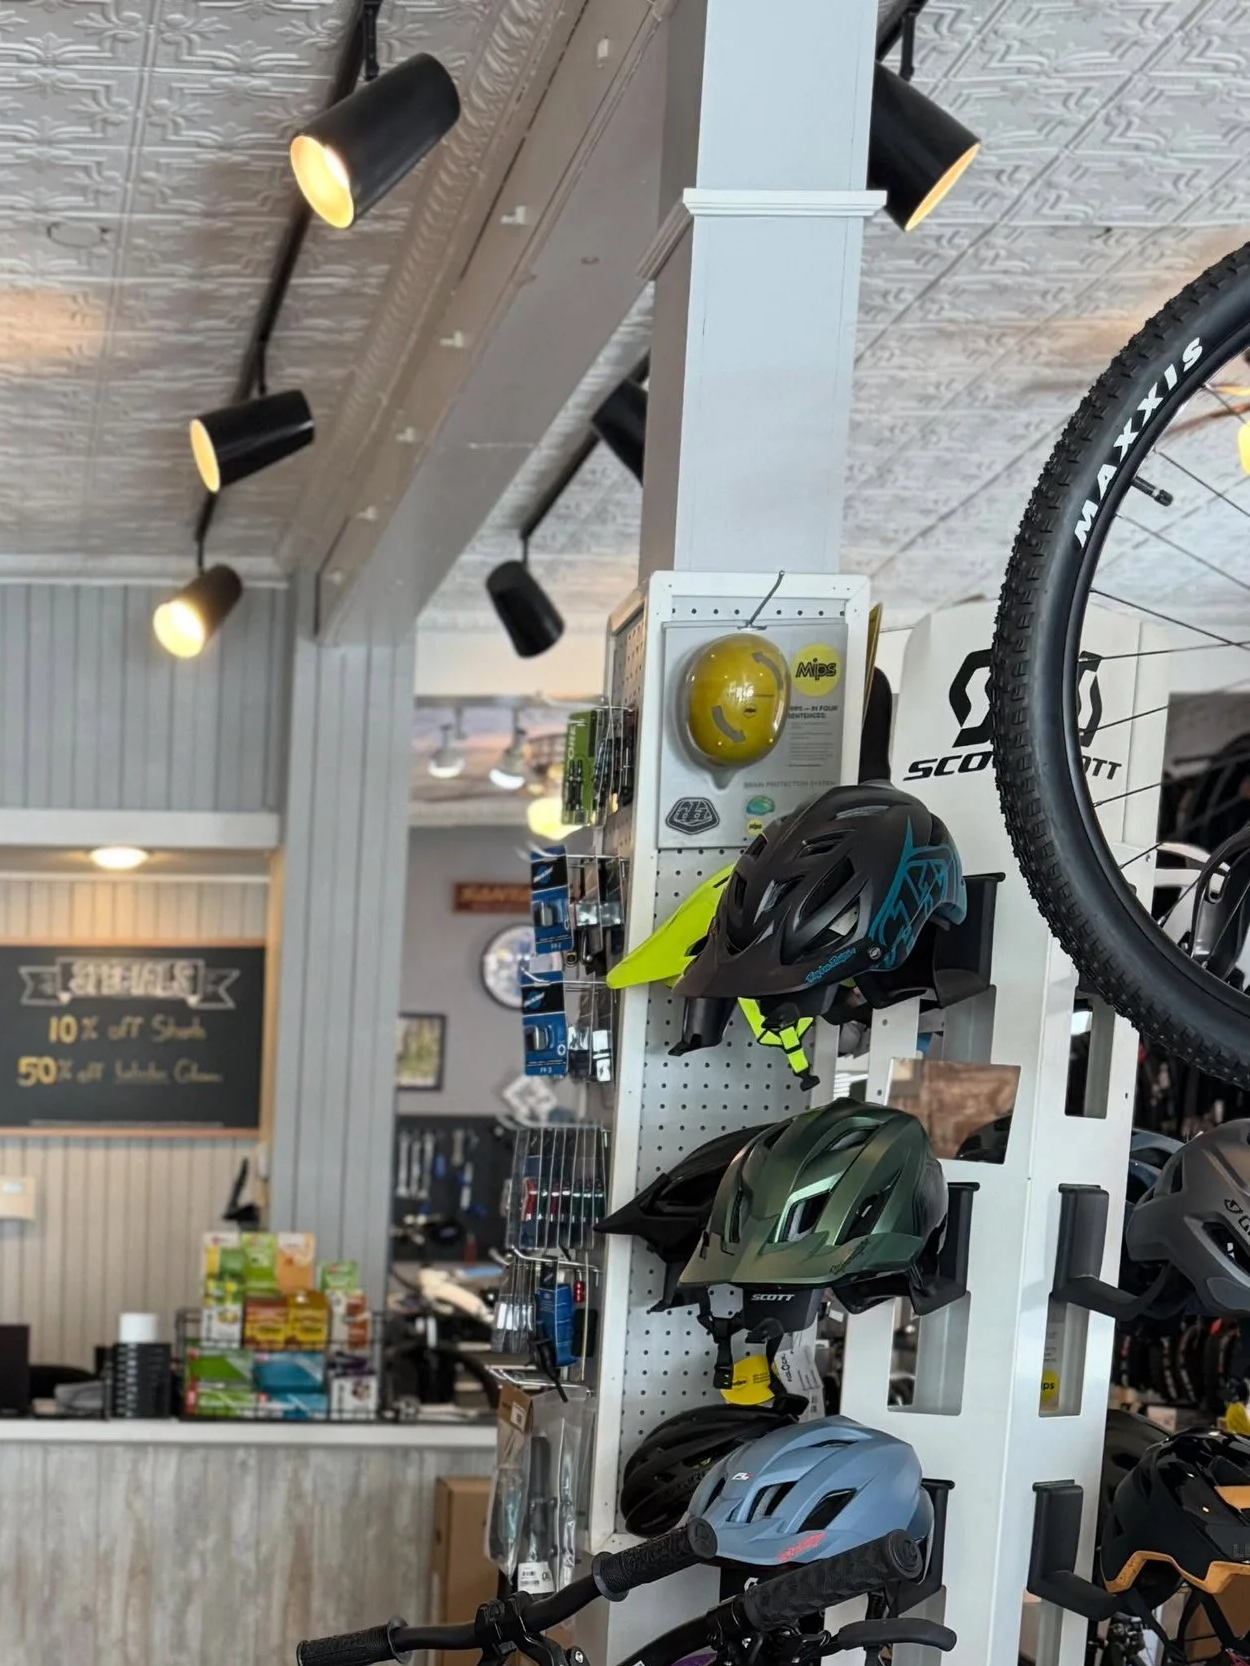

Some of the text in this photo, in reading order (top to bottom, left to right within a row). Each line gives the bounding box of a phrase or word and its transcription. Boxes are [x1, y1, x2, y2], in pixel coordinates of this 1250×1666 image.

[1075, 337, 1203, 549] MAXXIS
[795, 657, 837, 681] Mips
[903, 751, 994, 782] SCO
[750, 1293, 796, 1302] SCOTT
